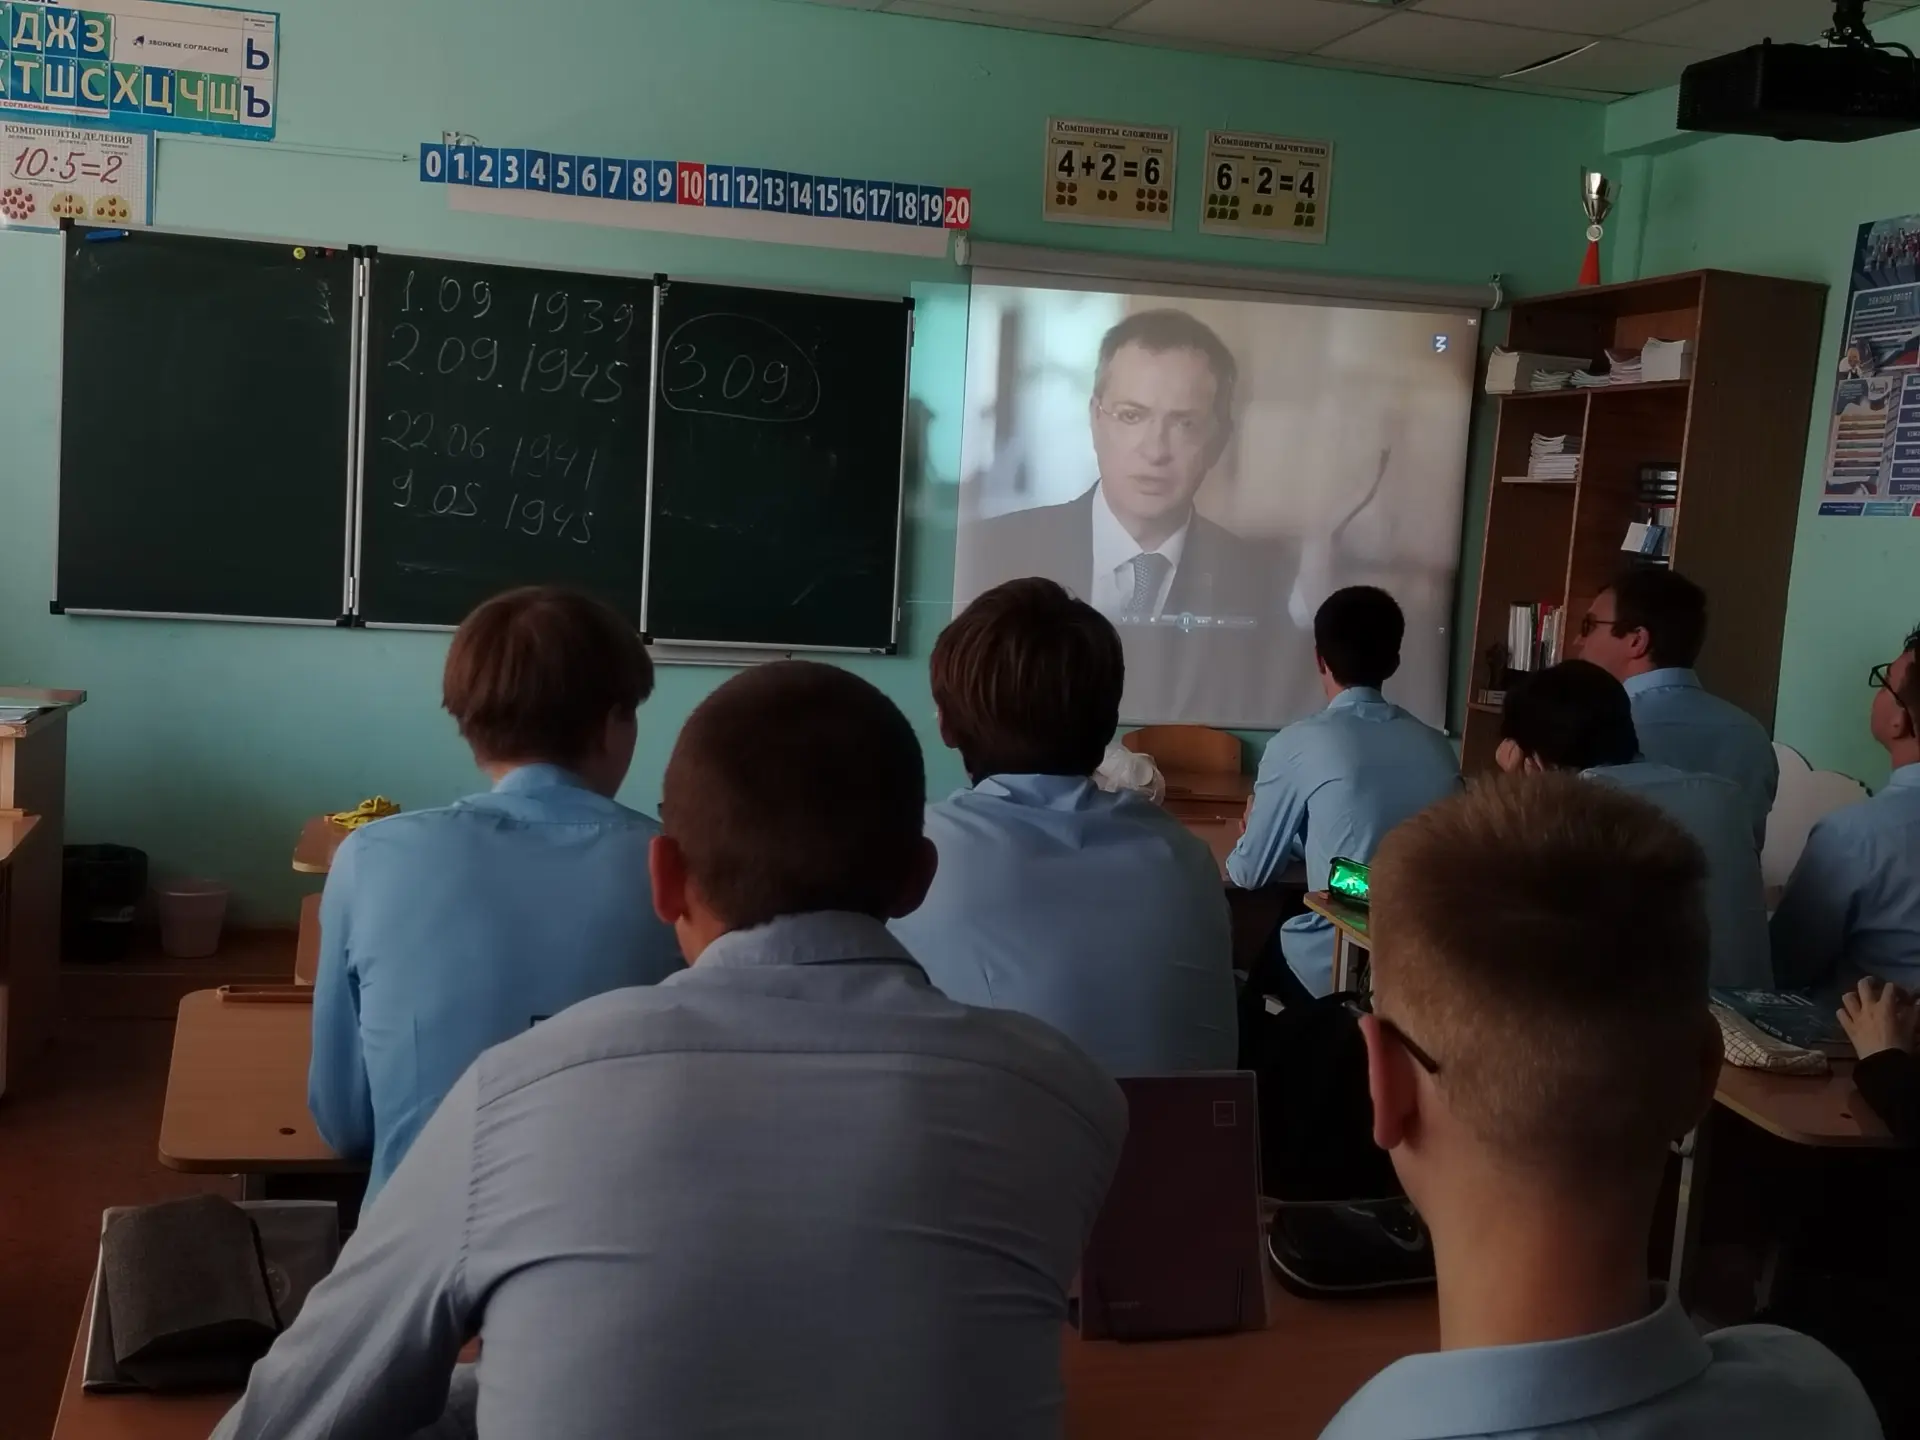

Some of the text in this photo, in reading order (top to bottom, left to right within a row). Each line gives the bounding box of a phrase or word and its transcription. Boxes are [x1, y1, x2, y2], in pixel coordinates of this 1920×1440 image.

[13, 12, 42, 51] Д
[46, 14, 76, 50] Ж
[148, 39, 229, 54] ЗВОНКИЕ СОГЛАСНЫЕ
[246, 37, 271, 71] Ь
[3, 101, 50, 111] СОГЛАСНЫЕ
[14, 60, 39, 95] Т
[46, 63, 74, 98] Ш
[81, 68, 105, 102] С
[113, 70, 139, 106] Х
[145, 74, 172, 114] Ц
[180, 78, 205, 112] Ч
[210, 81, 238, 121] Щ
[243, 85, 271, 118] Ъ
[5, 124, 81, 139] КОМПОНЕНТЫ
[83, 131, 133, 145] ДЕЛЕНИЯ
[1056, 121, 1169, 141] Компоненты сложения
[1213, 135, 1273, 150] Компоненты
[426, 151, 969, 224] 0 1 2 3 4 5 6 7 8 9 10 11 12 13 14 15 16 17 18 19 20
[528, 291, 634, 343] 1939
